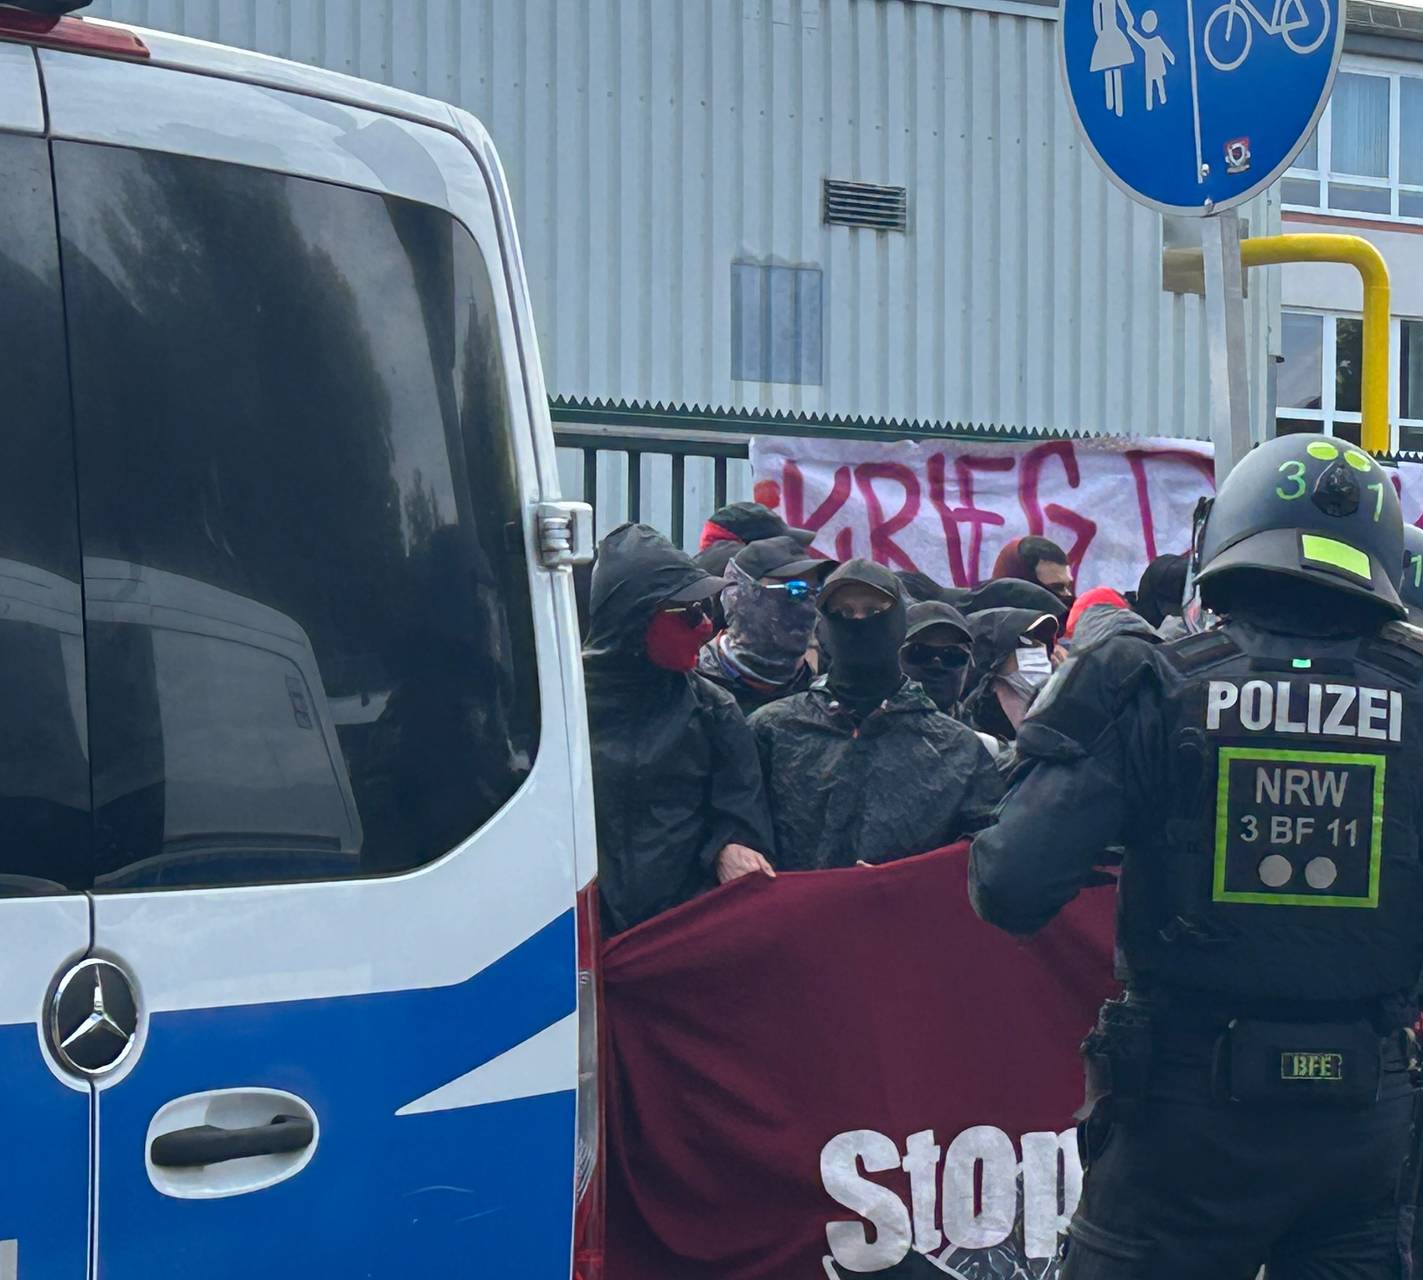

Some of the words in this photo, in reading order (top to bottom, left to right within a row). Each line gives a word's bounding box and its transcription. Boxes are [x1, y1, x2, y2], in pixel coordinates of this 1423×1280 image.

[1276, 460, 1307, 501] 3
[782, 440, 1098, 592] KRIEG
[1206, 679, 1403, 742] POLIZEI
[1255, 766, 1349, 808] NRW
[1239, 814, 1259, 843] 3
[1270, 815, 1316, 846] BF
[1327, 817, 1358, 848] 11
[1293, 1055, 1332, 1077] BFE
[819, 1124, 1085, 1273] Stop
